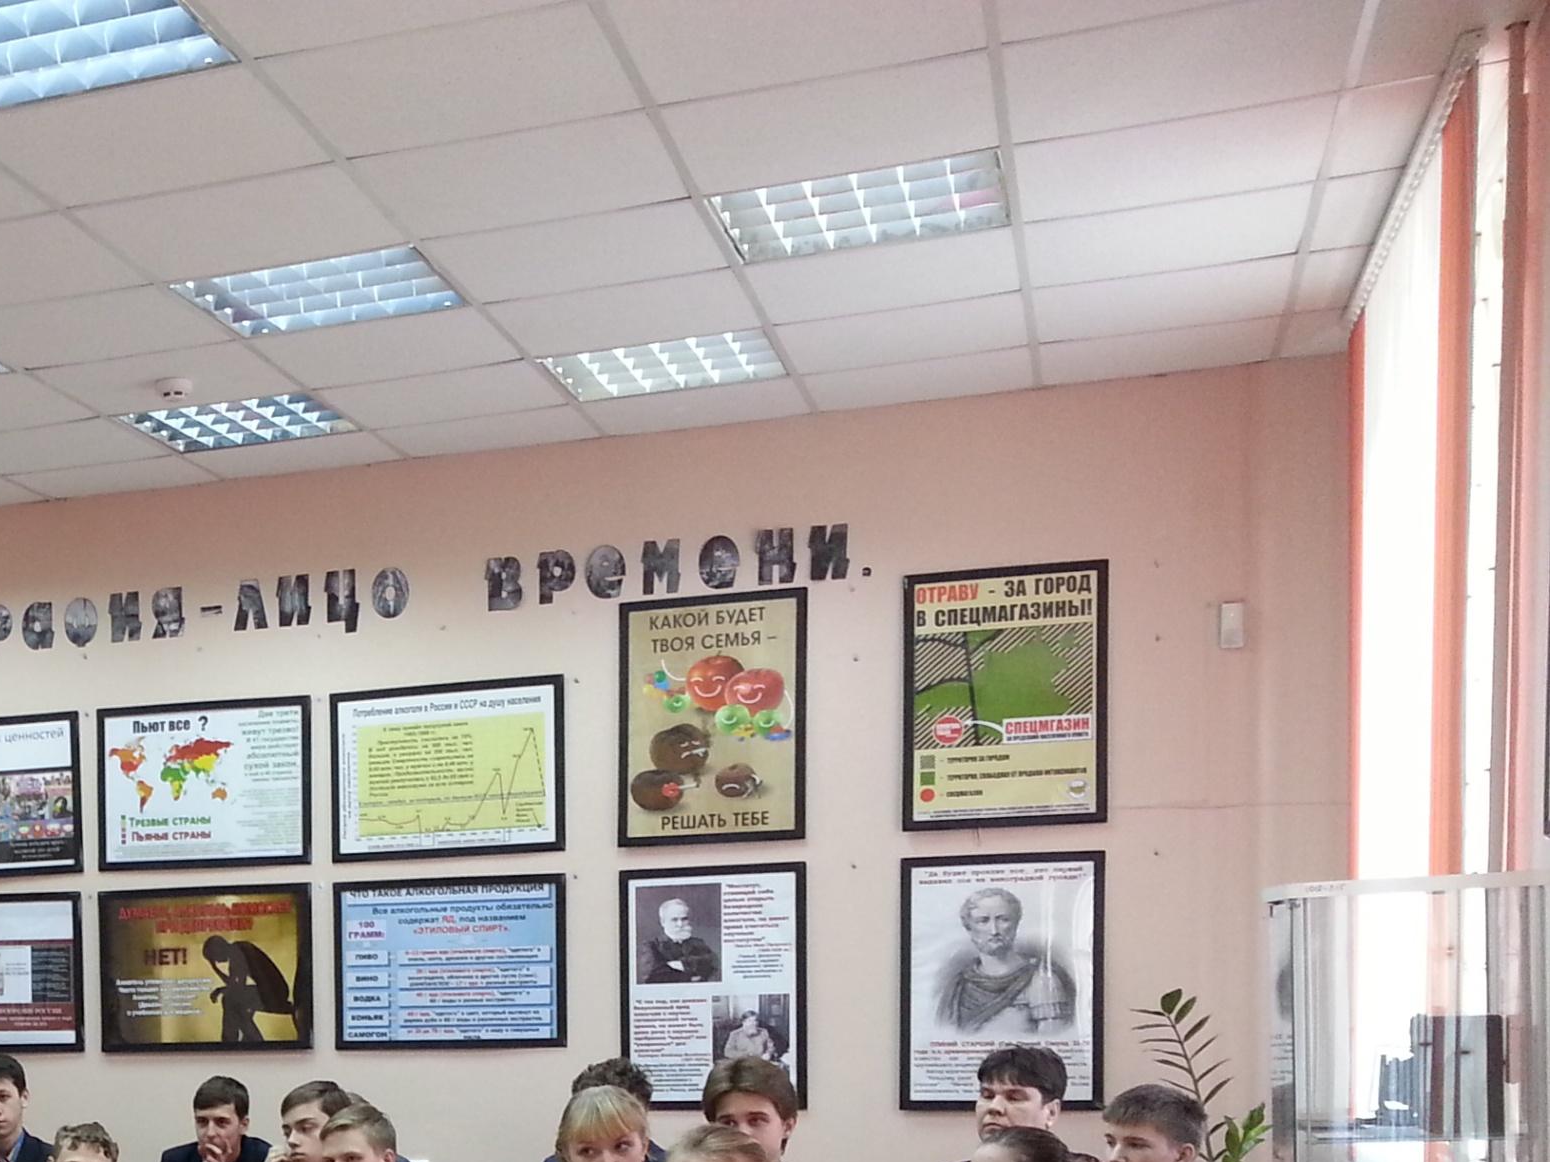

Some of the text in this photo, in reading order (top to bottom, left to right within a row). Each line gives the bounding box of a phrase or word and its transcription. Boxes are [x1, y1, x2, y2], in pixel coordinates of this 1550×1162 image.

[916, 582, 979, 605] ОТРАВУ
[1004, 580, 1026, 598] ЗА
[1034, 574, 1092, 596] ГОРОД
[650, 606, 766, 631] КАКОЙ БУДЕТ
[916, 610, 926, 628] В
[651, 637, 695, 654] ТВОЯ
[702, 630, 762, 650] СЕМЬЯ
[460, 699, 478, 710] СССР
[198, 715, 209, 732] ?
[4, 727, 65, 744] ценностей
[661, 811, 770, 831] РЕШАТЬ ТЕБЕ
[143, 947, 187, 967] НЕТ!
